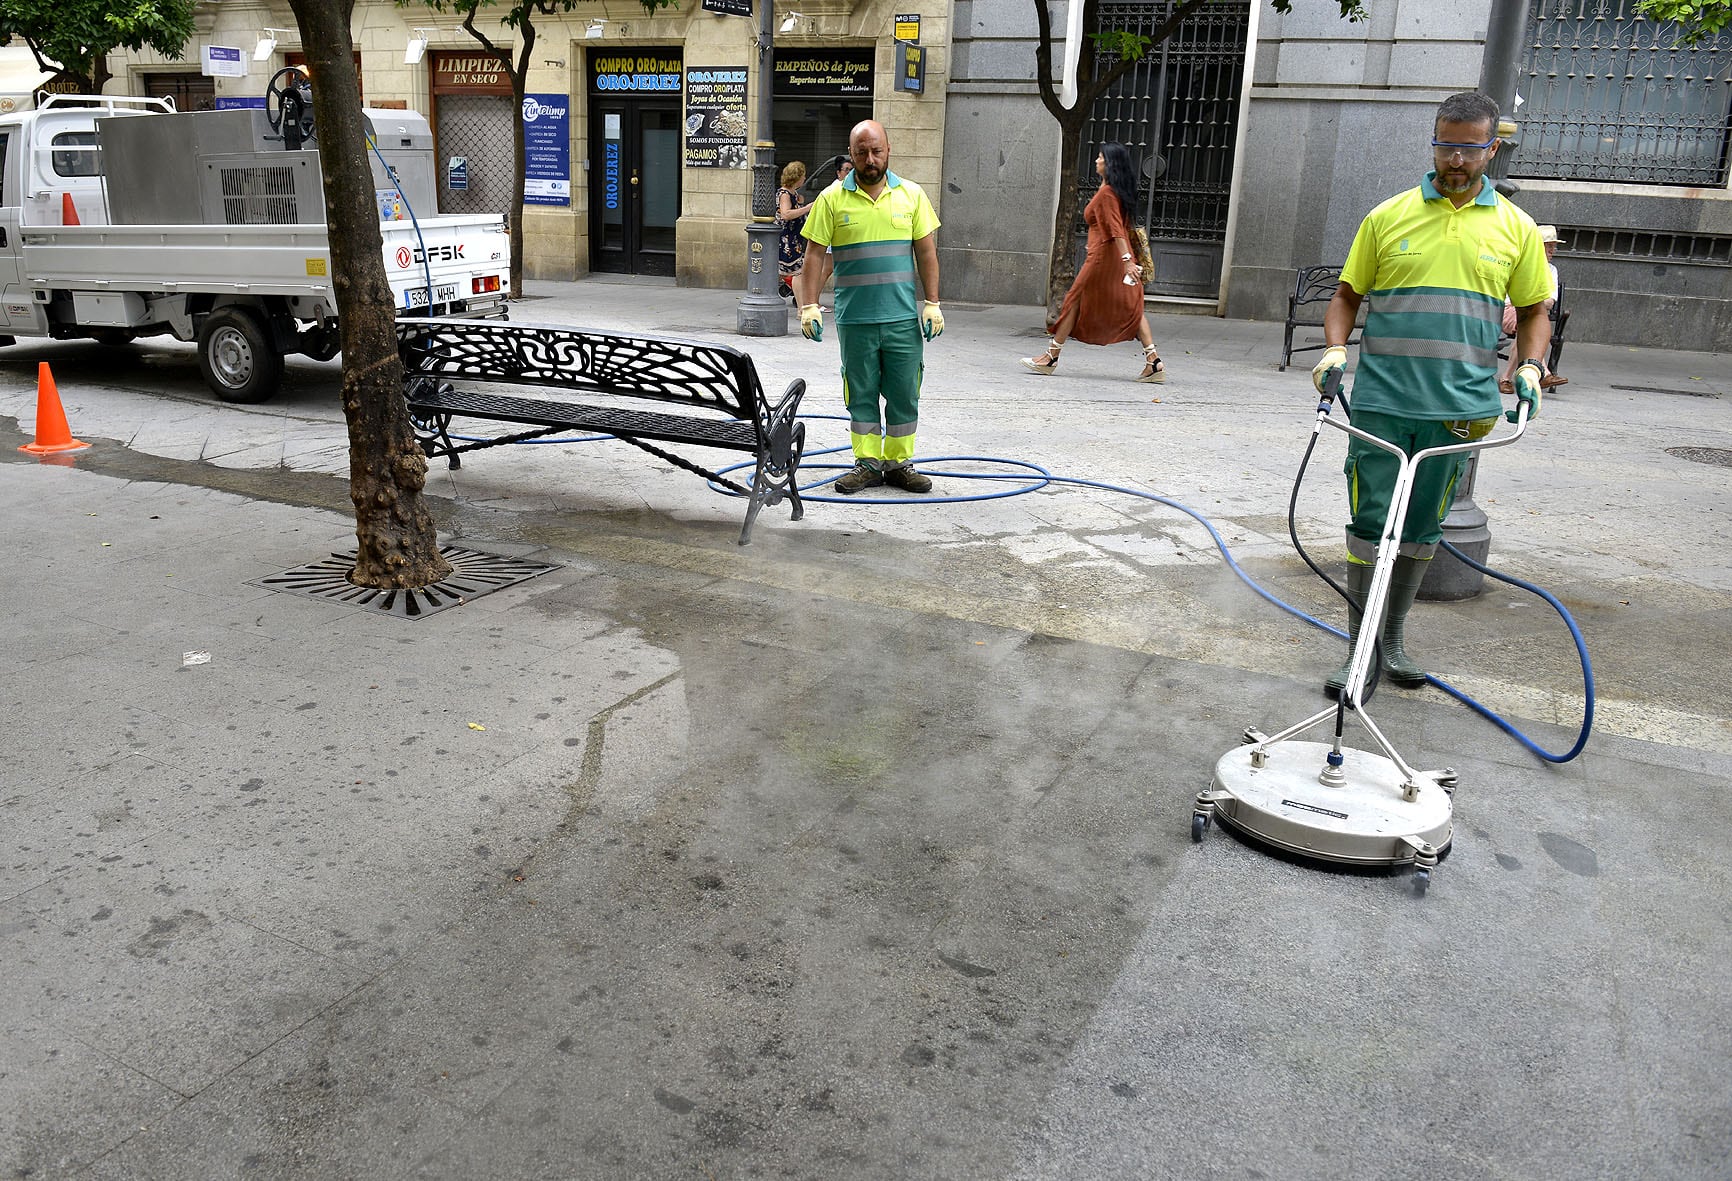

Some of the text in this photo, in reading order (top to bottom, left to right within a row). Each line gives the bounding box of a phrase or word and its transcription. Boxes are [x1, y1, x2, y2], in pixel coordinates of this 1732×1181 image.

[438, 58, 512, 72] LIMPIEZ
[595, 57, 682, 73] COMPRO ORO/PLATA
[774, 59, 870, 75] EMPEÑOS de Joyas
[453, 74, 498, 84] EN SECO
[597, 74, 681, 90] OROJEREZ
[688, 71, 747, 83] OROJEREZ
[789, 76, 817, 86] Expertos
[826, 75, 854, 84] Tasación
[688, 84, 713, 93] COMPRO
[690, 94, 743, 104] Joyas de Ocasión
[725, 103, 747, 111] oferta
[685, 148, 718, 160] PAGAMOS
[606, 143, 618, 209] OROJEREZ
[413, 245, 465, 264] DFSK
[437, 286, 456, 302] MHH
